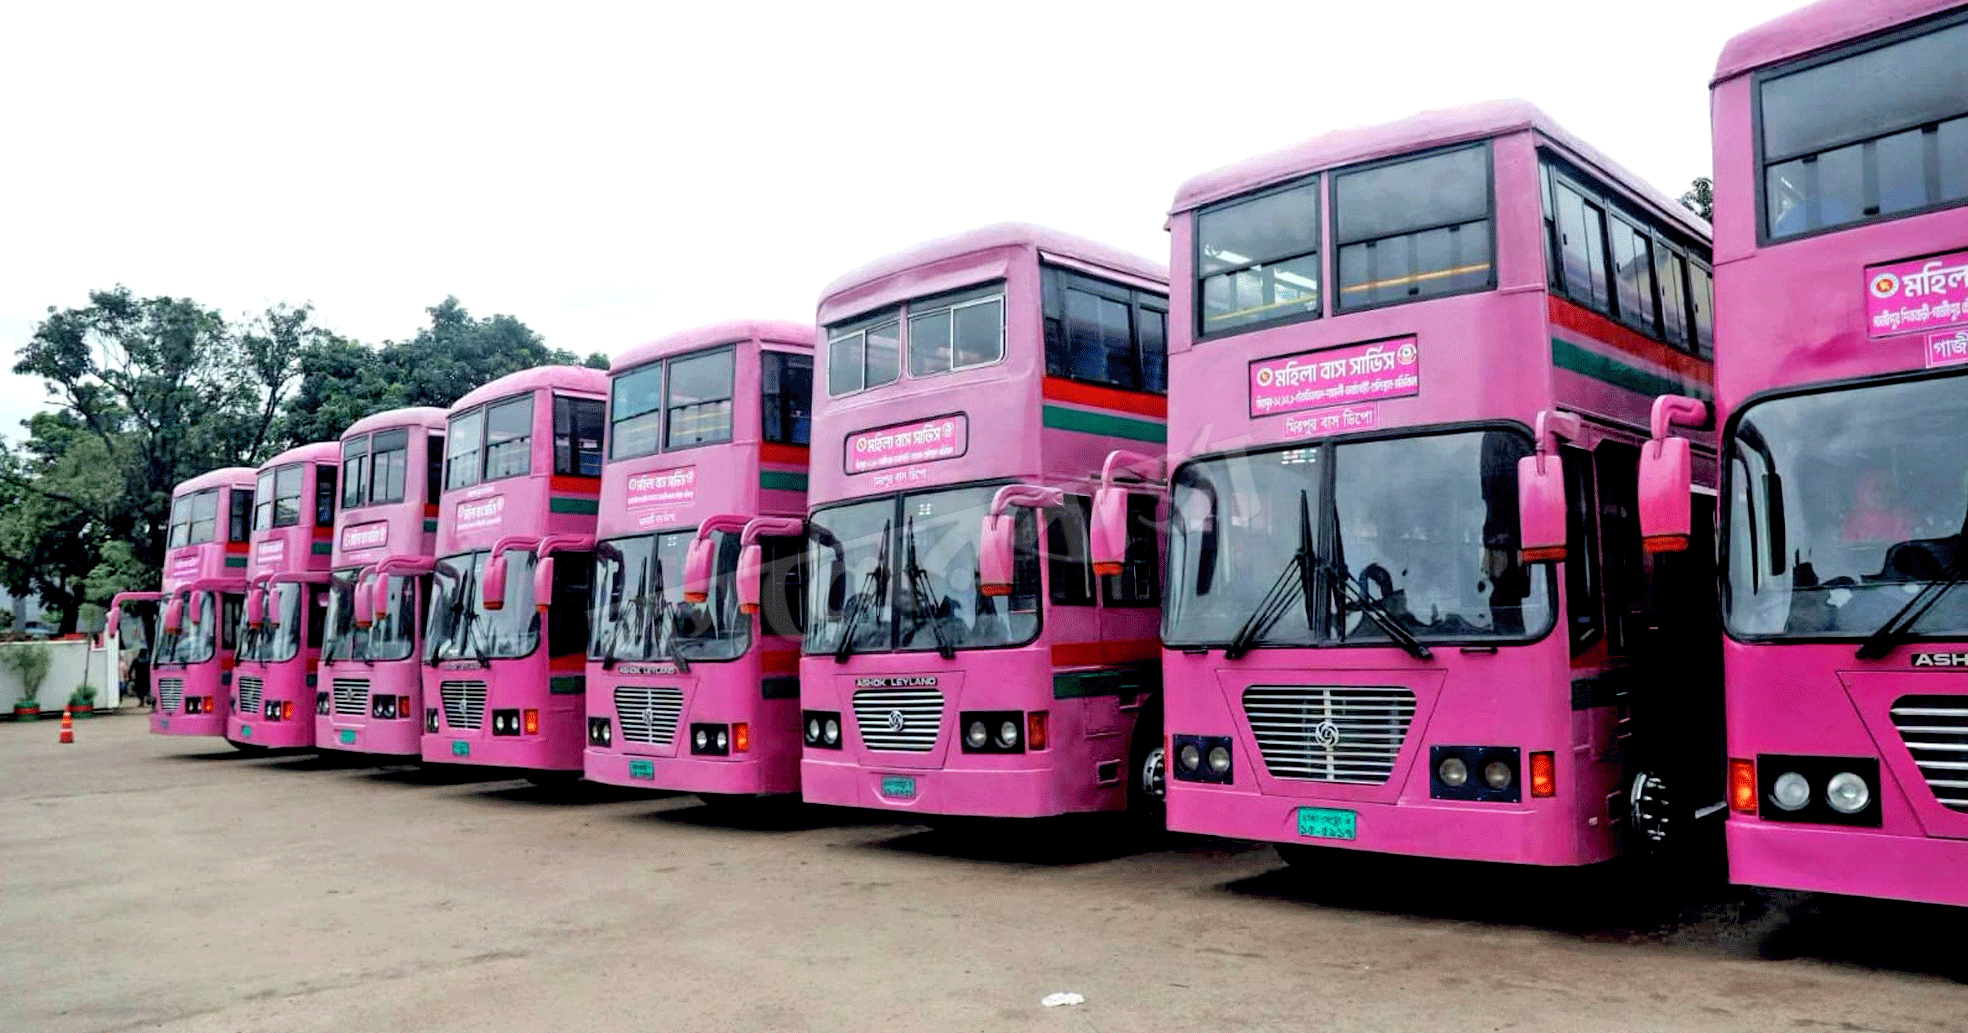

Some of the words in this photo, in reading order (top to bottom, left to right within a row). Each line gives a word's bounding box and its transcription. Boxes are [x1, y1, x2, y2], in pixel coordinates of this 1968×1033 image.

[1275, 361, 1317, 388] মহিলা
[1320, 358, 1346, 380] বাস
[1350, 346, 1395, 376] সার্ভিস
[1321, 414, 1340, 429] বাস
[1915, 653, 1968, 667] ASH
[856, 678, 887, 687] ASHOK
[890, 677, 937, 687] LEYLAND
